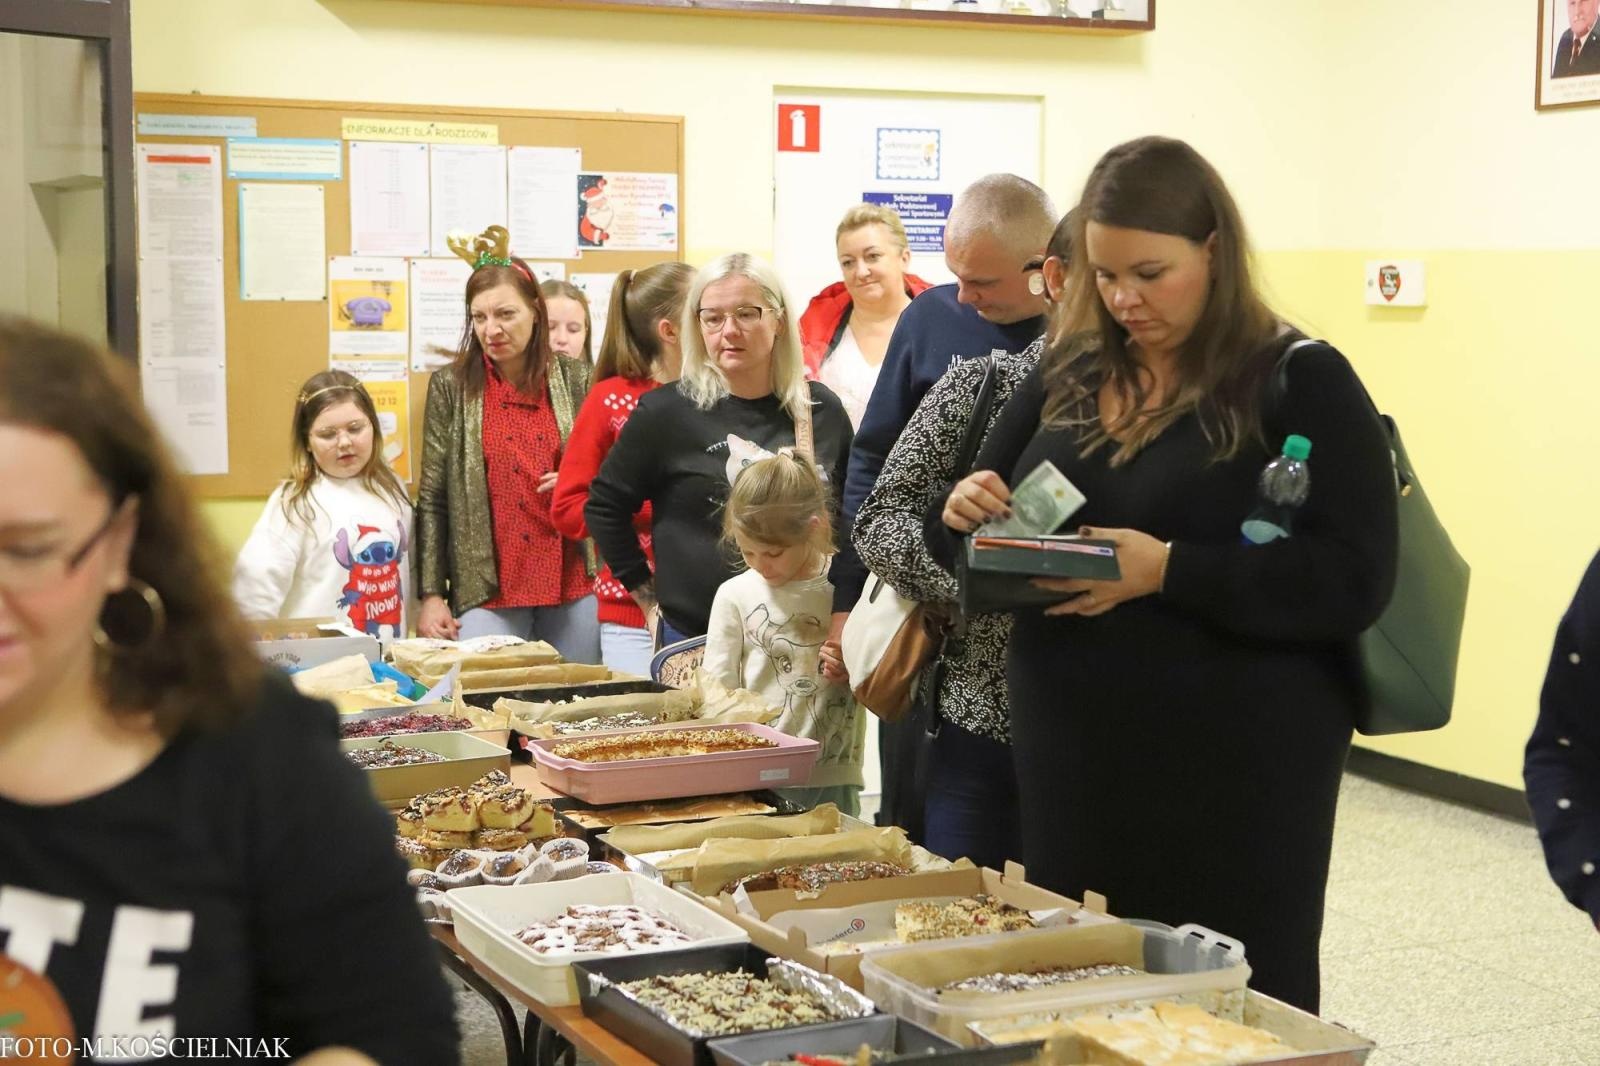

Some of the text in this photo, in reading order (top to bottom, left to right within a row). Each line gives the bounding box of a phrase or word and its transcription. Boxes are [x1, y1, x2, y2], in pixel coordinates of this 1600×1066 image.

[346, 124, 489, 140] INFORMACJE DLA RODZICÓW
[357, 579, 378, 595] WHO
[365, 594, 398, 620] SNOW?
